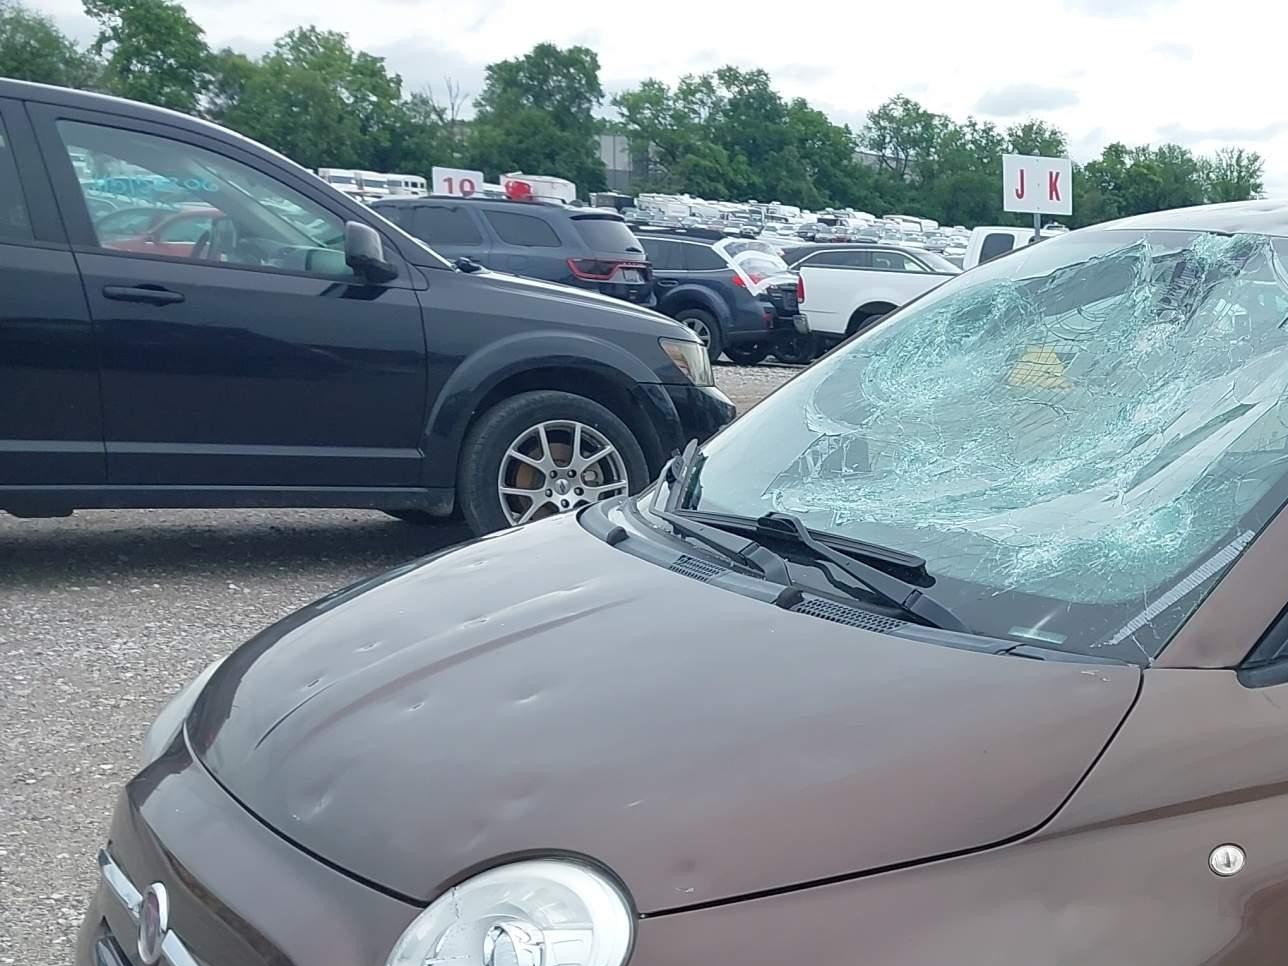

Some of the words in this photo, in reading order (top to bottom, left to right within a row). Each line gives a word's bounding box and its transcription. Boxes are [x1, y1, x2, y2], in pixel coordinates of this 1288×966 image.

[442, 176, 476, 197] 10
[1015, 168, 1025, 200] J
[1048, 170, 1061, 202] K
